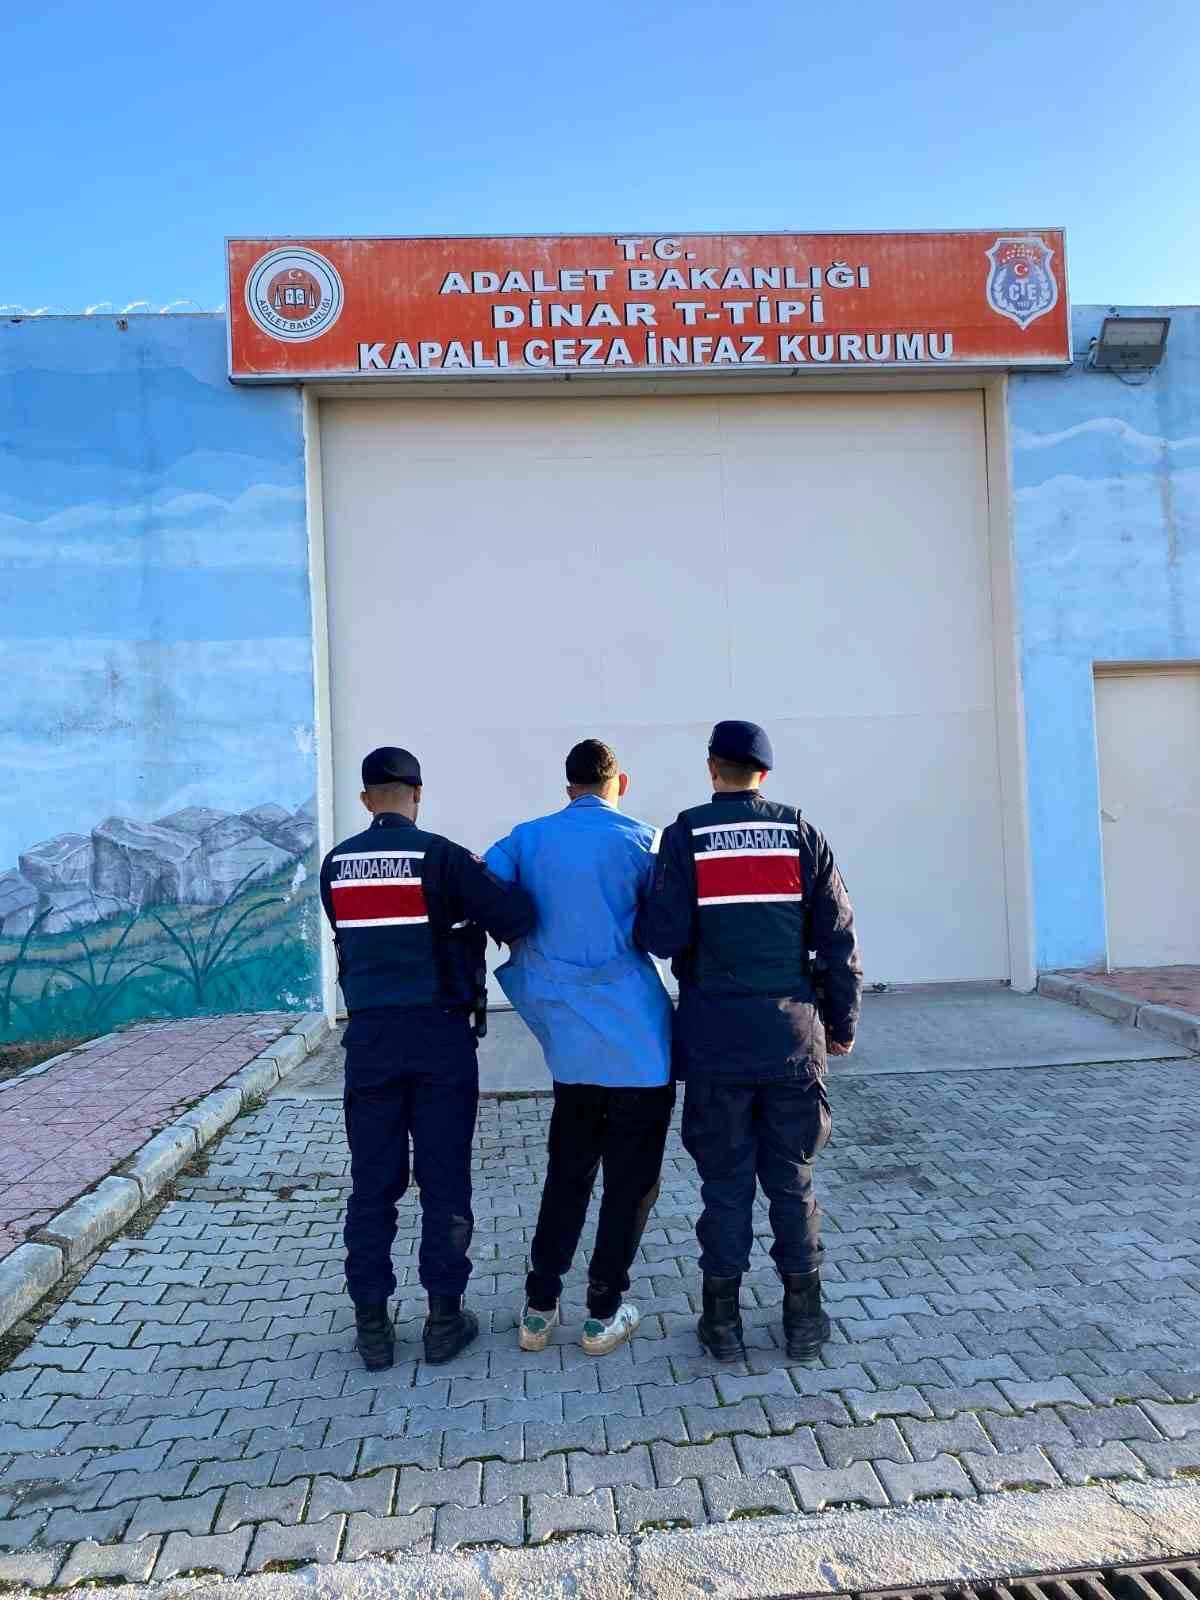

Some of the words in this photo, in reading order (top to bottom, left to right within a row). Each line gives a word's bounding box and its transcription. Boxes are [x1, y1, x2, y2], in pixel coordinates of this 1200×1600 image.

[615, 238, 696, 262] T.C.
[439, 268, 614, 295] ADALET
[629, 262, 869, 292] BAKANLIĞI
[259, 299, 289, 328] ADALET
[492, 299, 657, 328] DİNAR
[674, 295, 825, 326] T-TİPİ
[358, 340, 510, 370] KAPALI
[523, 338, 633, 368] CEZA
[645, 334, 765, 365] İNFAZ
[778, 332, 954, 363] KURUMU
[703, 829, 789, 852] JANDARMA
[336, 858, 412, 882] JANDARMA
